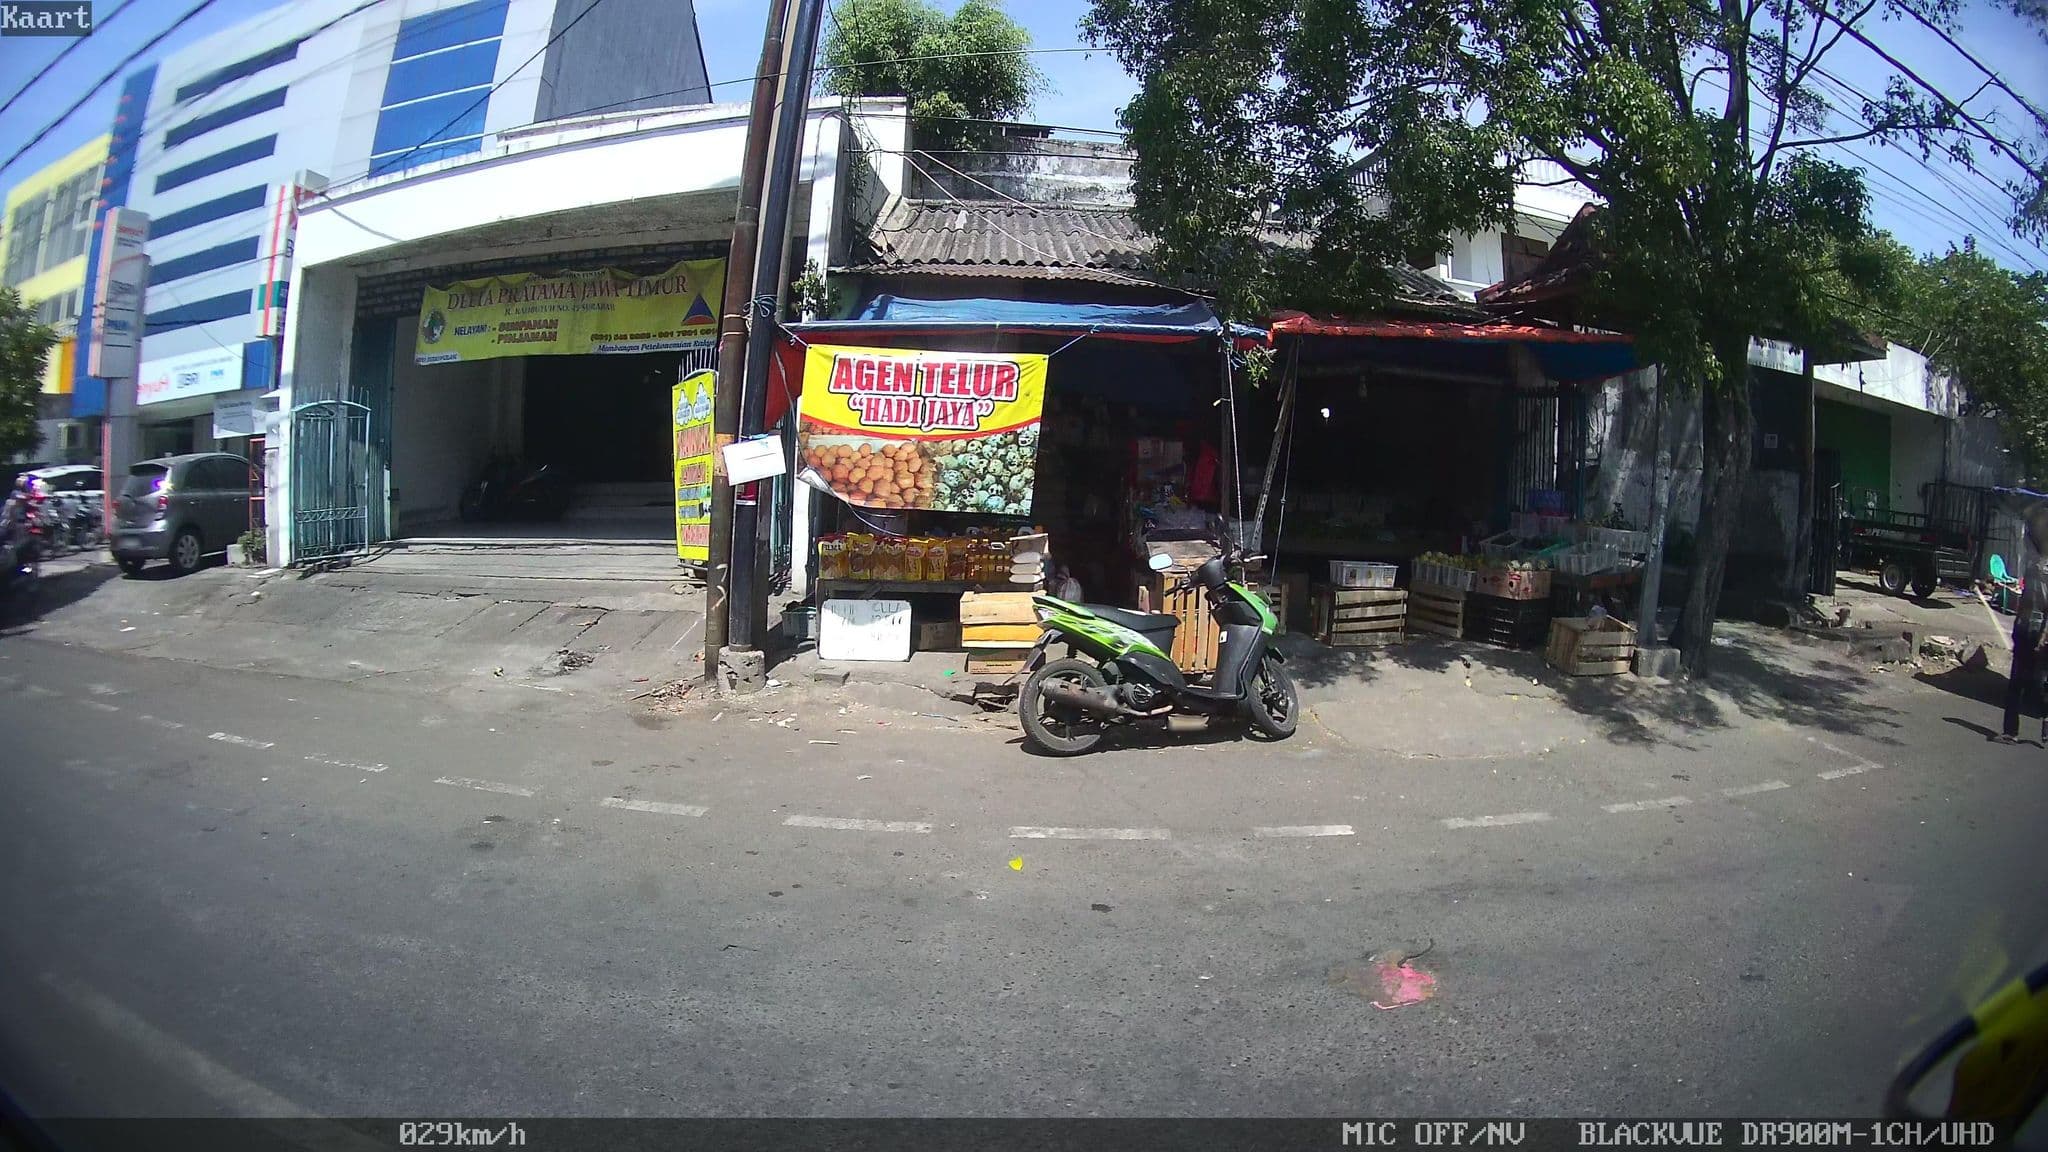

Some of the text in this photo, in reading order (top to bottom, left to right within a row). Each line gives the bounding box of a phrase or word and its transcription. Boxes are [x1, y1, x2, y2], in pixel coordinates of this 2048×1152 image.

[447, 287, 494, 309] DELTA
[498, 282, 577, 304] PRATAMA
[627, 275, 688, 297] TIMUR
[832, 356, 1018, 399] AGEN TELUR
